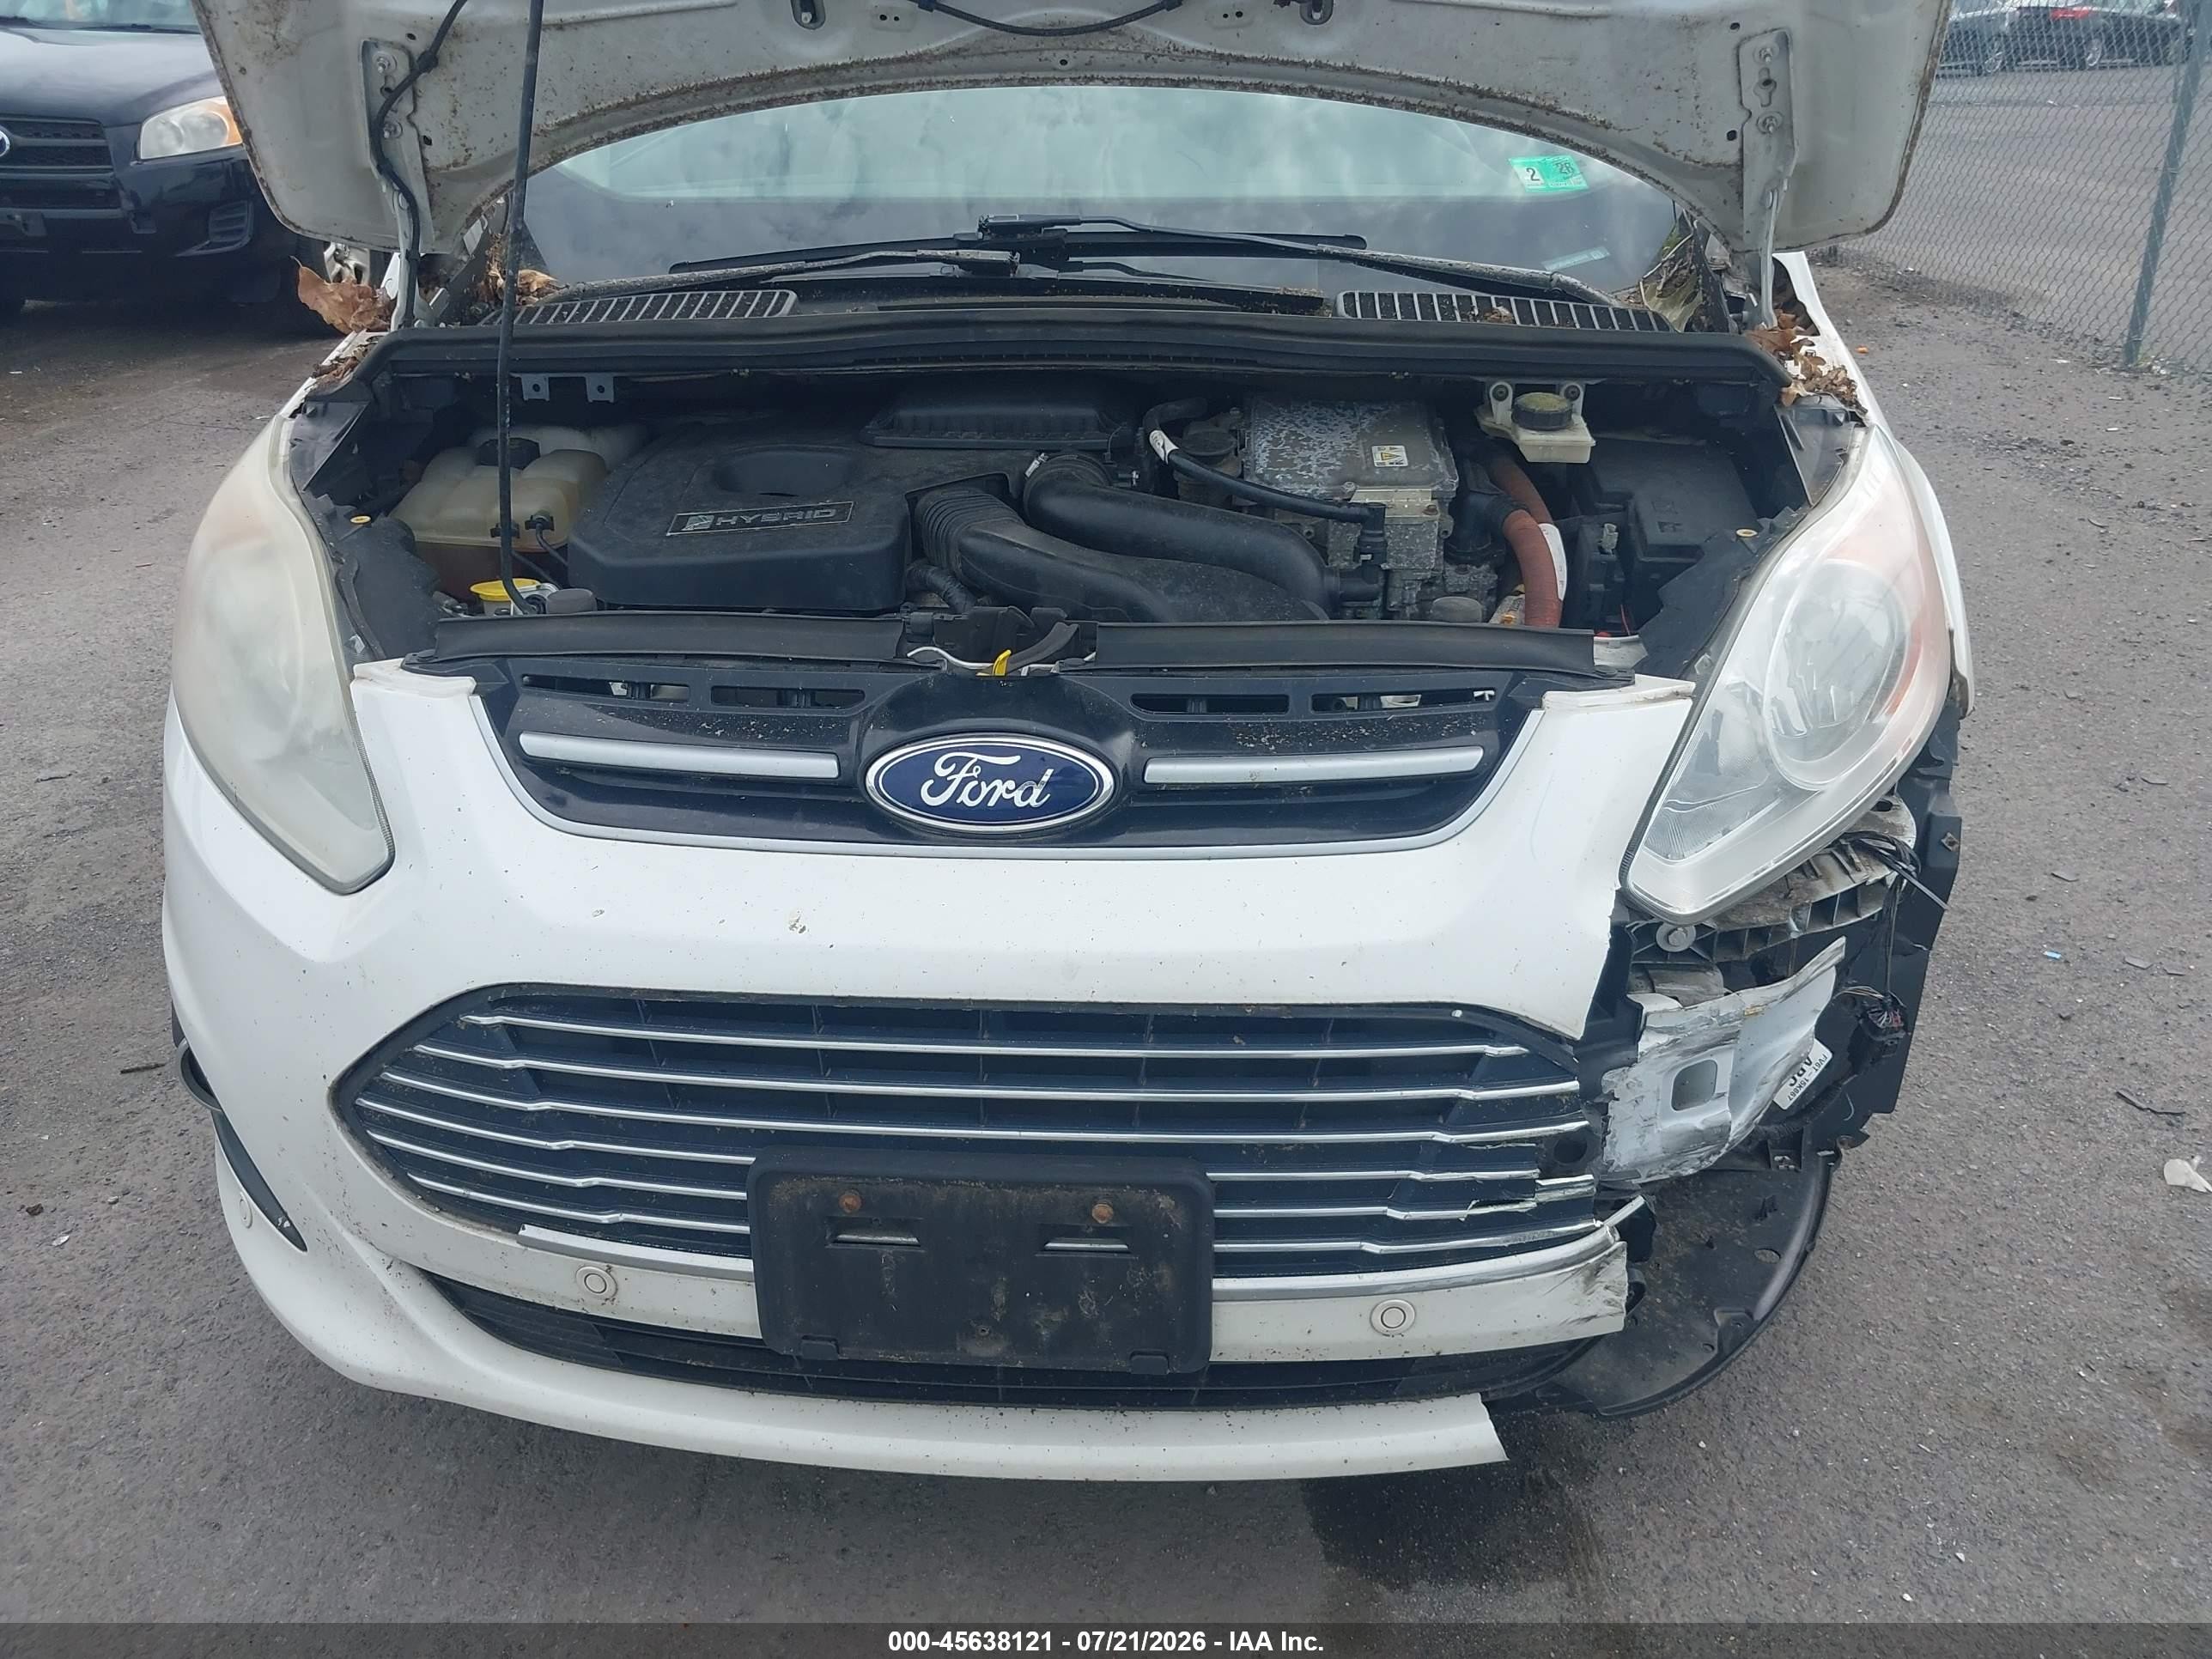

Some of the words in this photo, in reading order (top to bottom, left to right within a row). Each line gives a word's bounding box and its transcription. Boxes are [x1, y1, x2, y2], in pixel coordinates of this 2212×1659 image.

[1526, 167, 1540, 181] 2
[715, 508, 837, 526] HYBRID
[921, 751, 1054, 808] Ford
